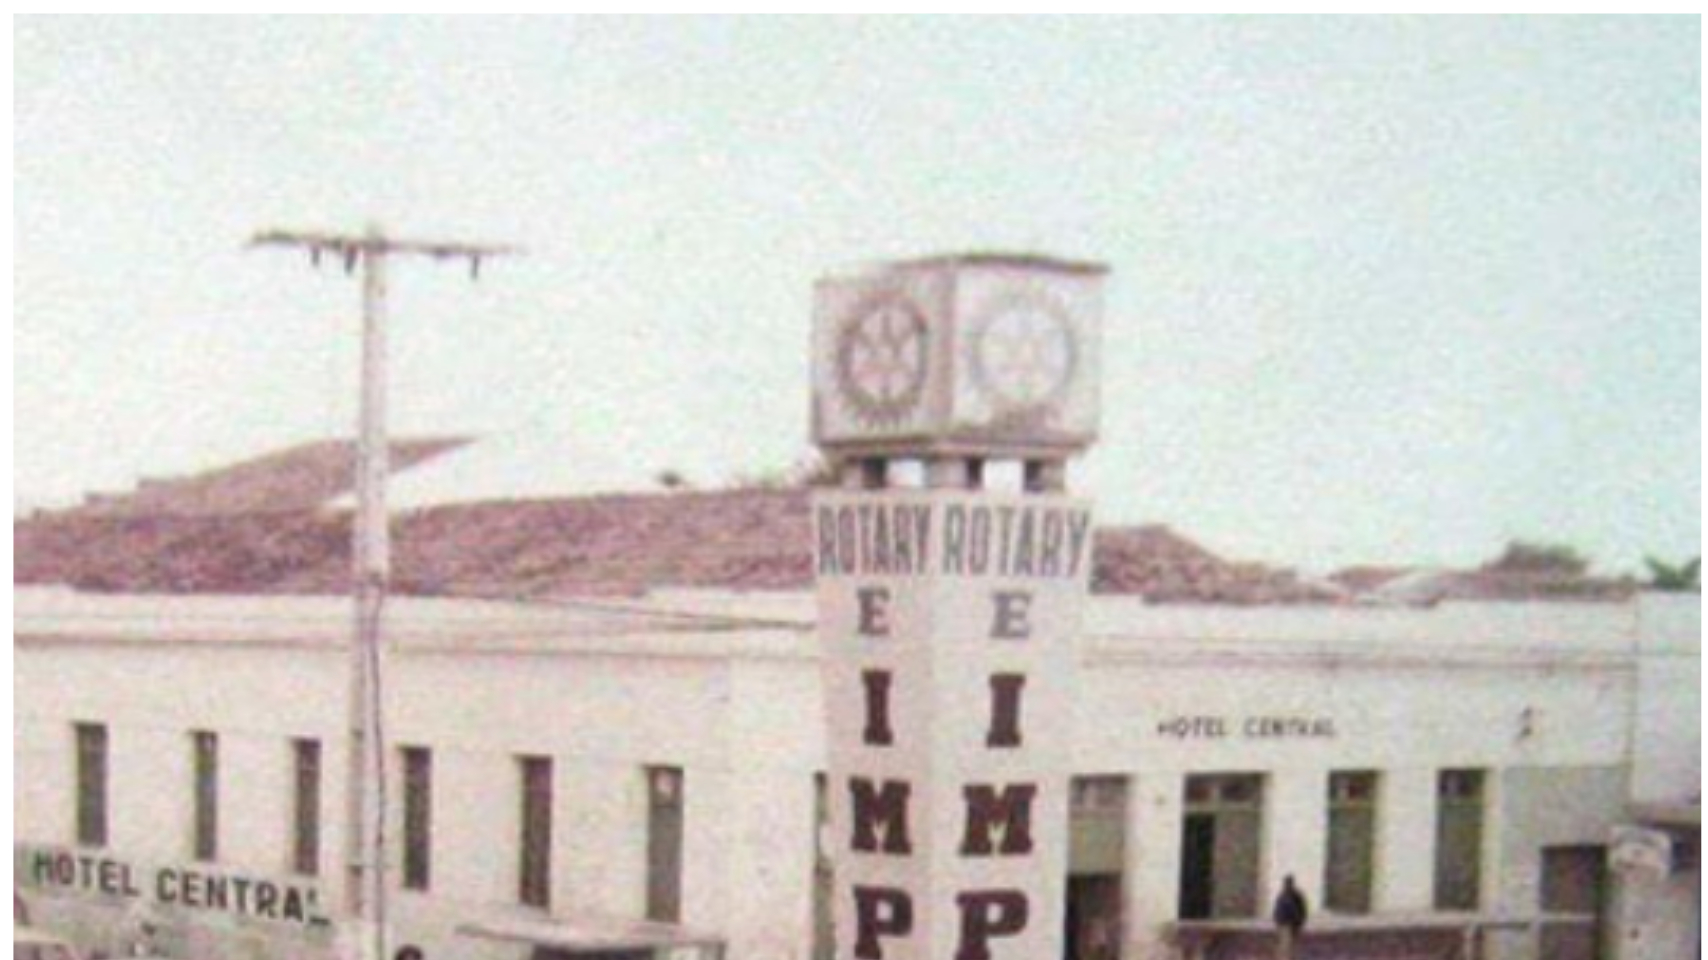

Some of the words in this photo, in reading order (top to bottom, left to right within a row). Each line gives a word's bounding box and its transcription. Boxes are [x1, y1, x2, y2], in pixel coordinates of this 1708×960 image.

[818, 503, 931, 577] ROTARY
[942, 503, 1089, 577] ROTARY
[857, 587, 891, 636] E
[989, 591, 1032, 639] E
[1156, 715, 1228, 740] HOTEL
[1243, 715, 1337, 739] CENTRAL
[32, 852, 140, 897] HOTEL
[155, 867, 331, 926] CENTRAL
